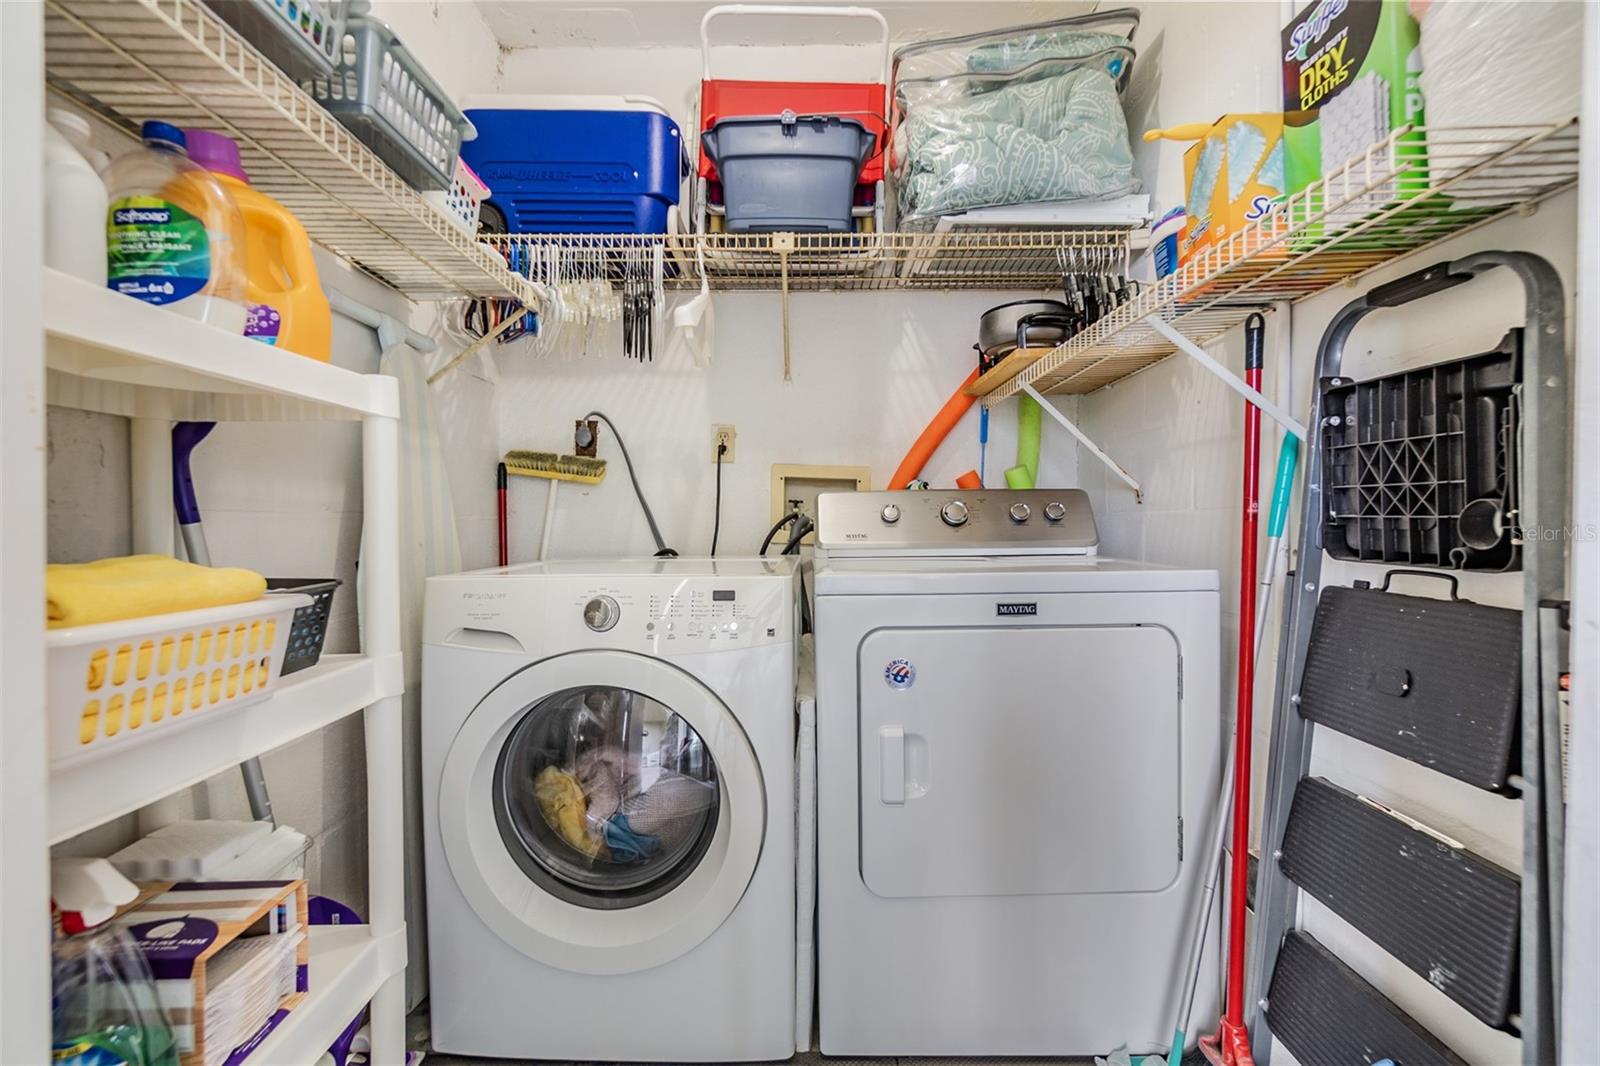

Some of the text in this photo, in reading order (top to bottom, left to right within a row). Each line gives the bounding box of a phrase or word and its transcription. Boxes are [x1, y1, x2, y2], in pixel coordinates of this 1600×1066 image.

[1285, 0, 1348, 61] Swiffe
[1300, 26, 1349, 73] HEAVY DUTY
[1299, 37, 1348, 99] DRY
[1301, 67, 1349, 111] CLOTHS
[115, 209, 169, 223] Softsoap
[149, 231, 181, 239] CLEAN
[999, 605, 1036, 614] MAYTAG
[885, 658, 909, 679] AMERICA
